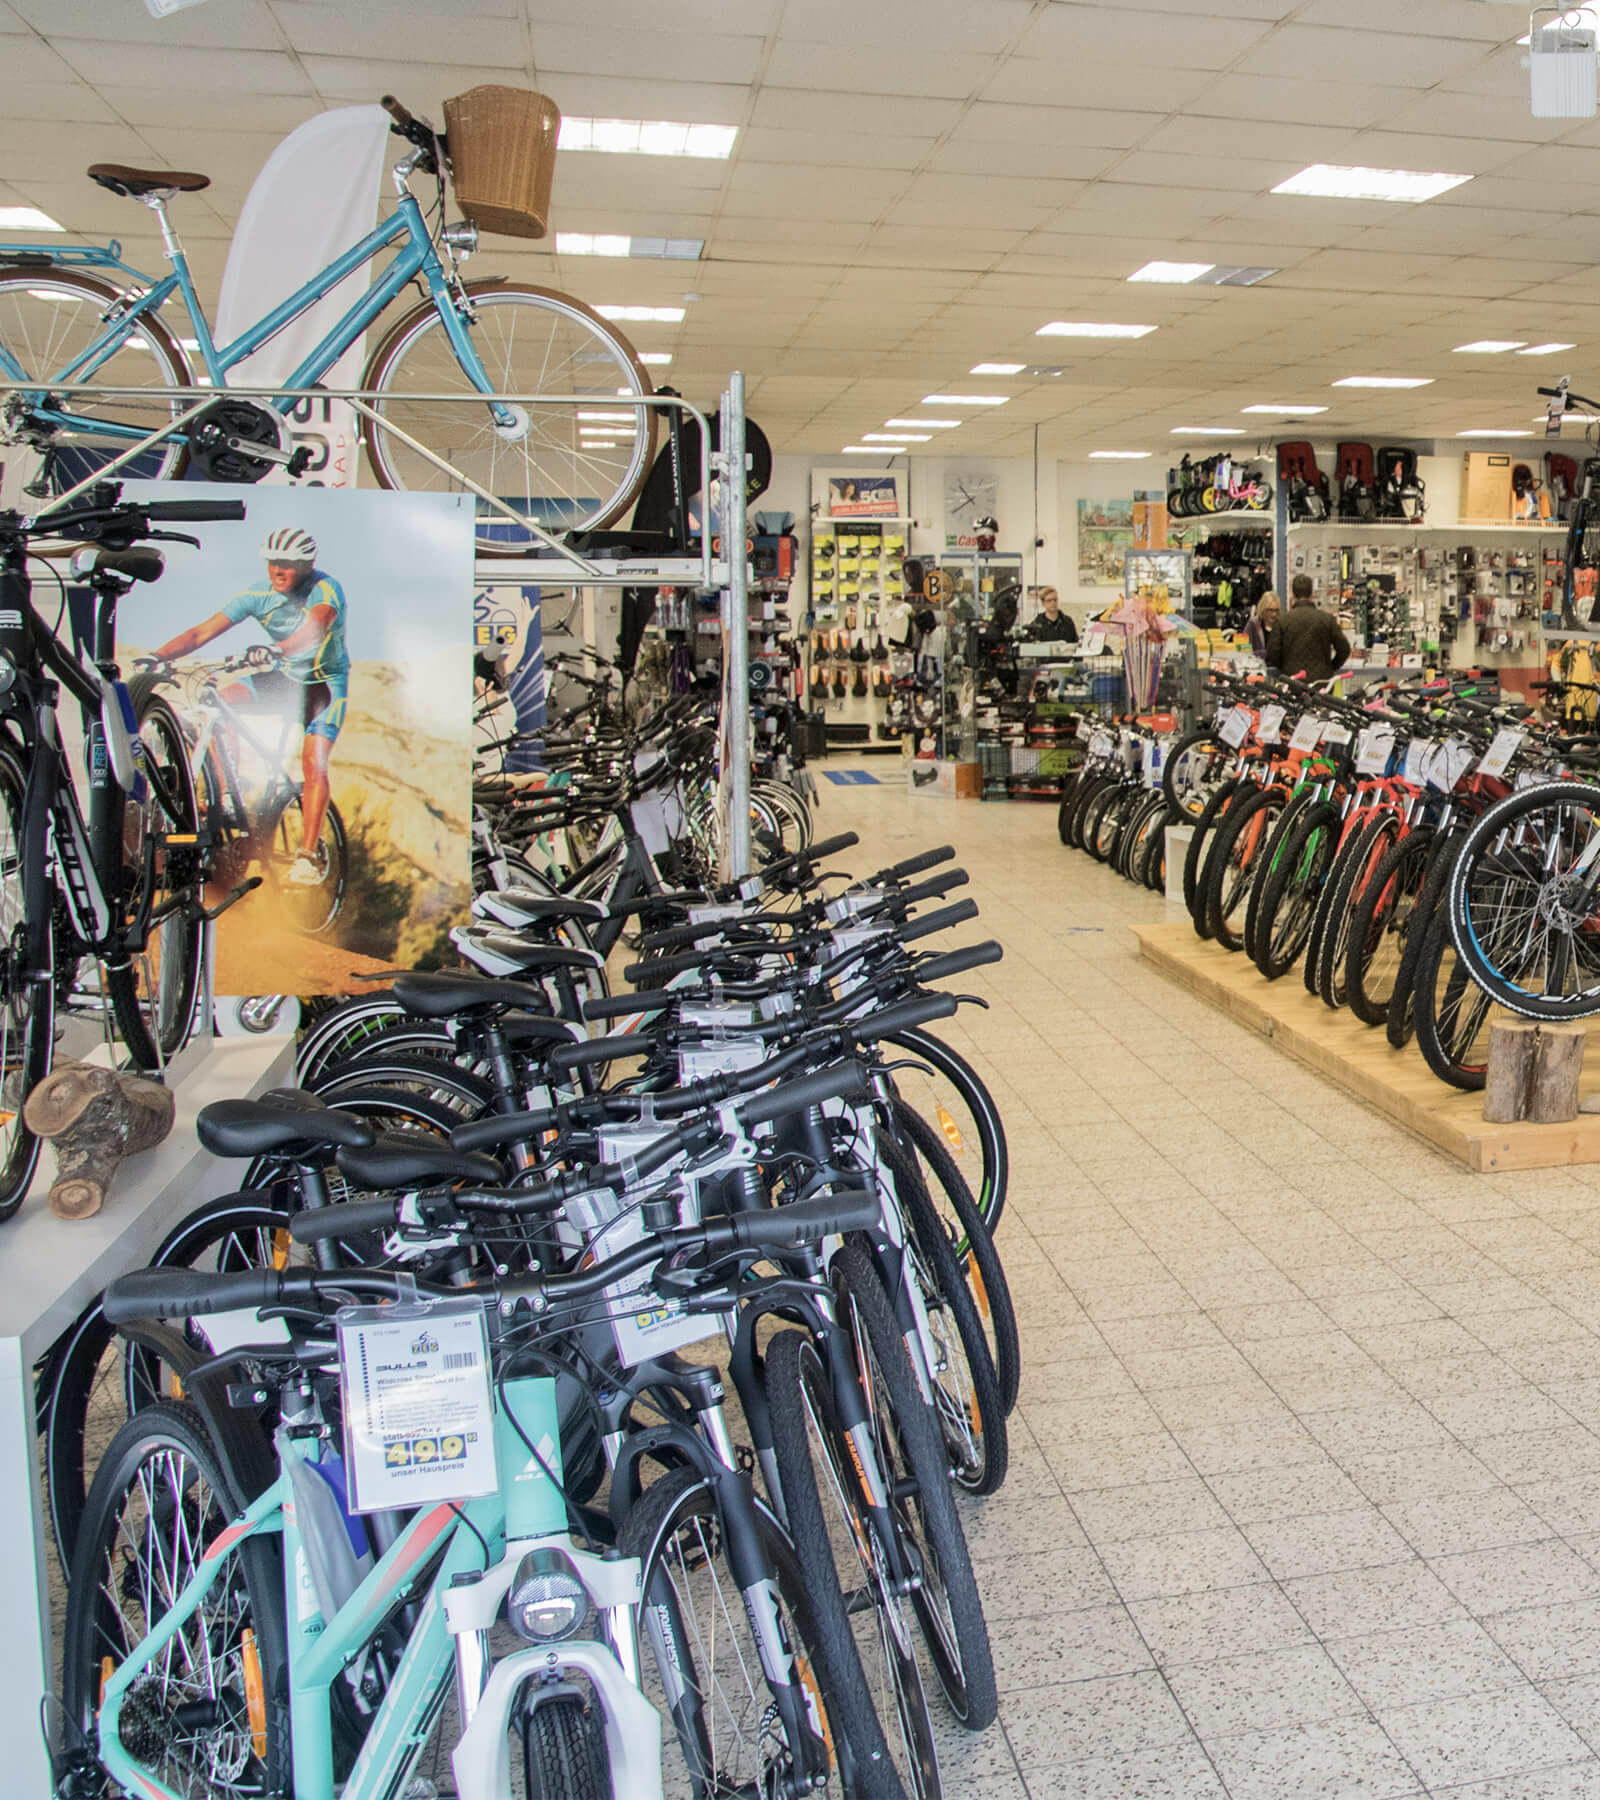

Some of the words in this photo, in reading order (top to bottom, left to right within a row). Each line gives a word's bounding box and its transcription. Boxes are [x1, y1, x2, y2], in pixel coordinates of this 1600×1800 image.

[475, 626, 518, 646] EG
[385, 1434, 467, 1467] 499
[391, 1468, 417, 1479] unser
[419, 1462, 465, 1475] Hauspreis
